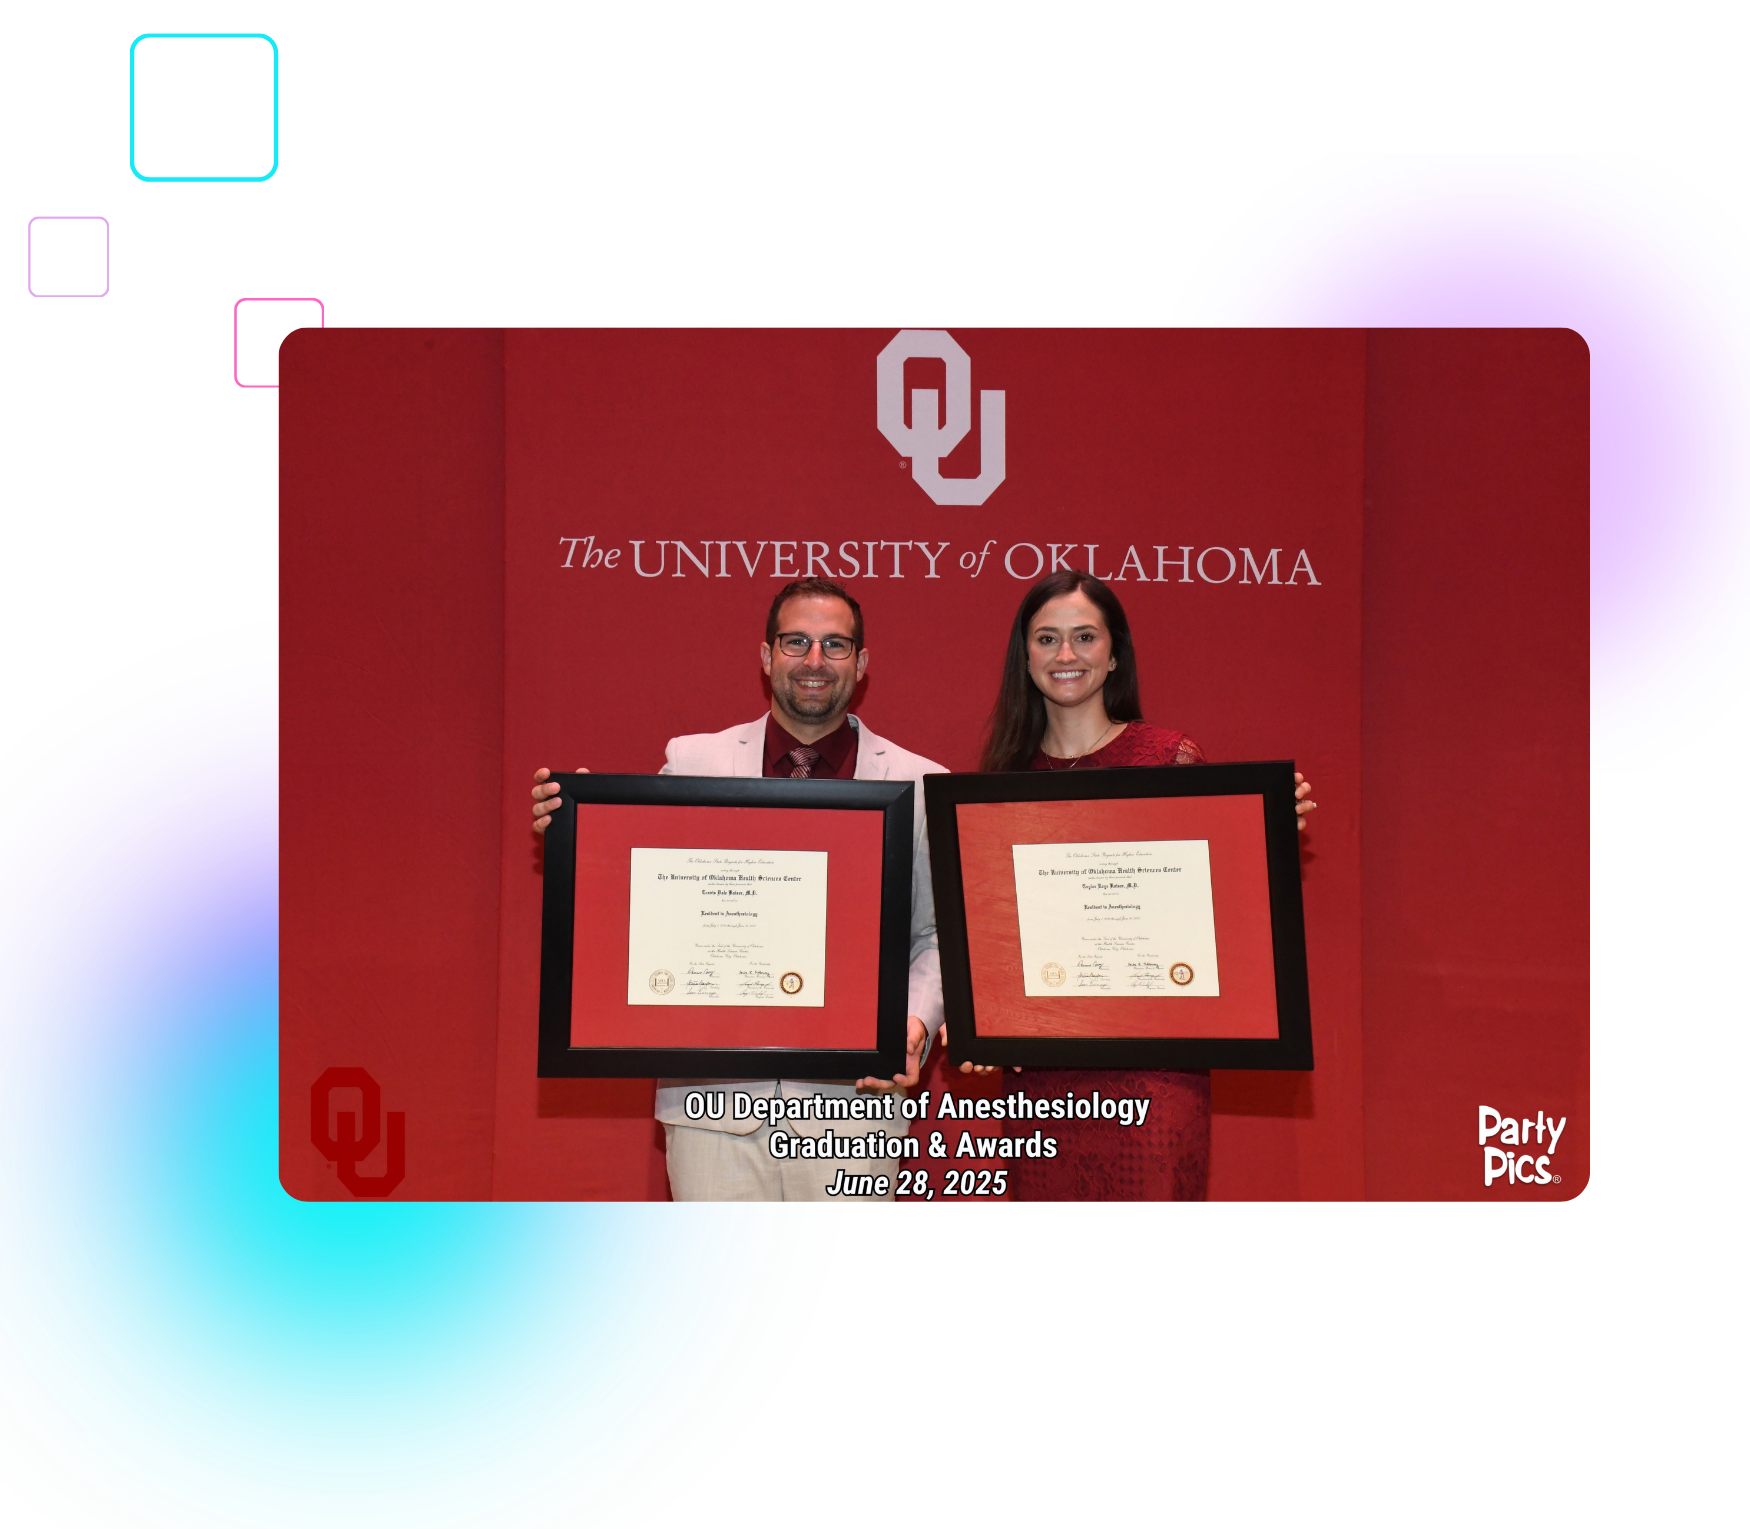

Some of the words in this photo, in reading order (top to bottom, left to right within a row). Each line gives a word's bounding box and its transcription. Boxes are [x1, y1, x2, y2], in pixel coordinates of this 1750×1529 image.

[877, 329, 1006, 506] OU
[558, 535, 621, 569] The
[629, 539, 950, 578] UNIVERSITY
[959, 539, 997, 578] of
[1004, 542, 1322, 586] OKLAHOMA
[670, 873, 700, 881] University
[708, 874, 737, 882] Oklahoma
[1050, 869, 1079, 877] University
[1088, 868, 1116, 876] Oklahoma
